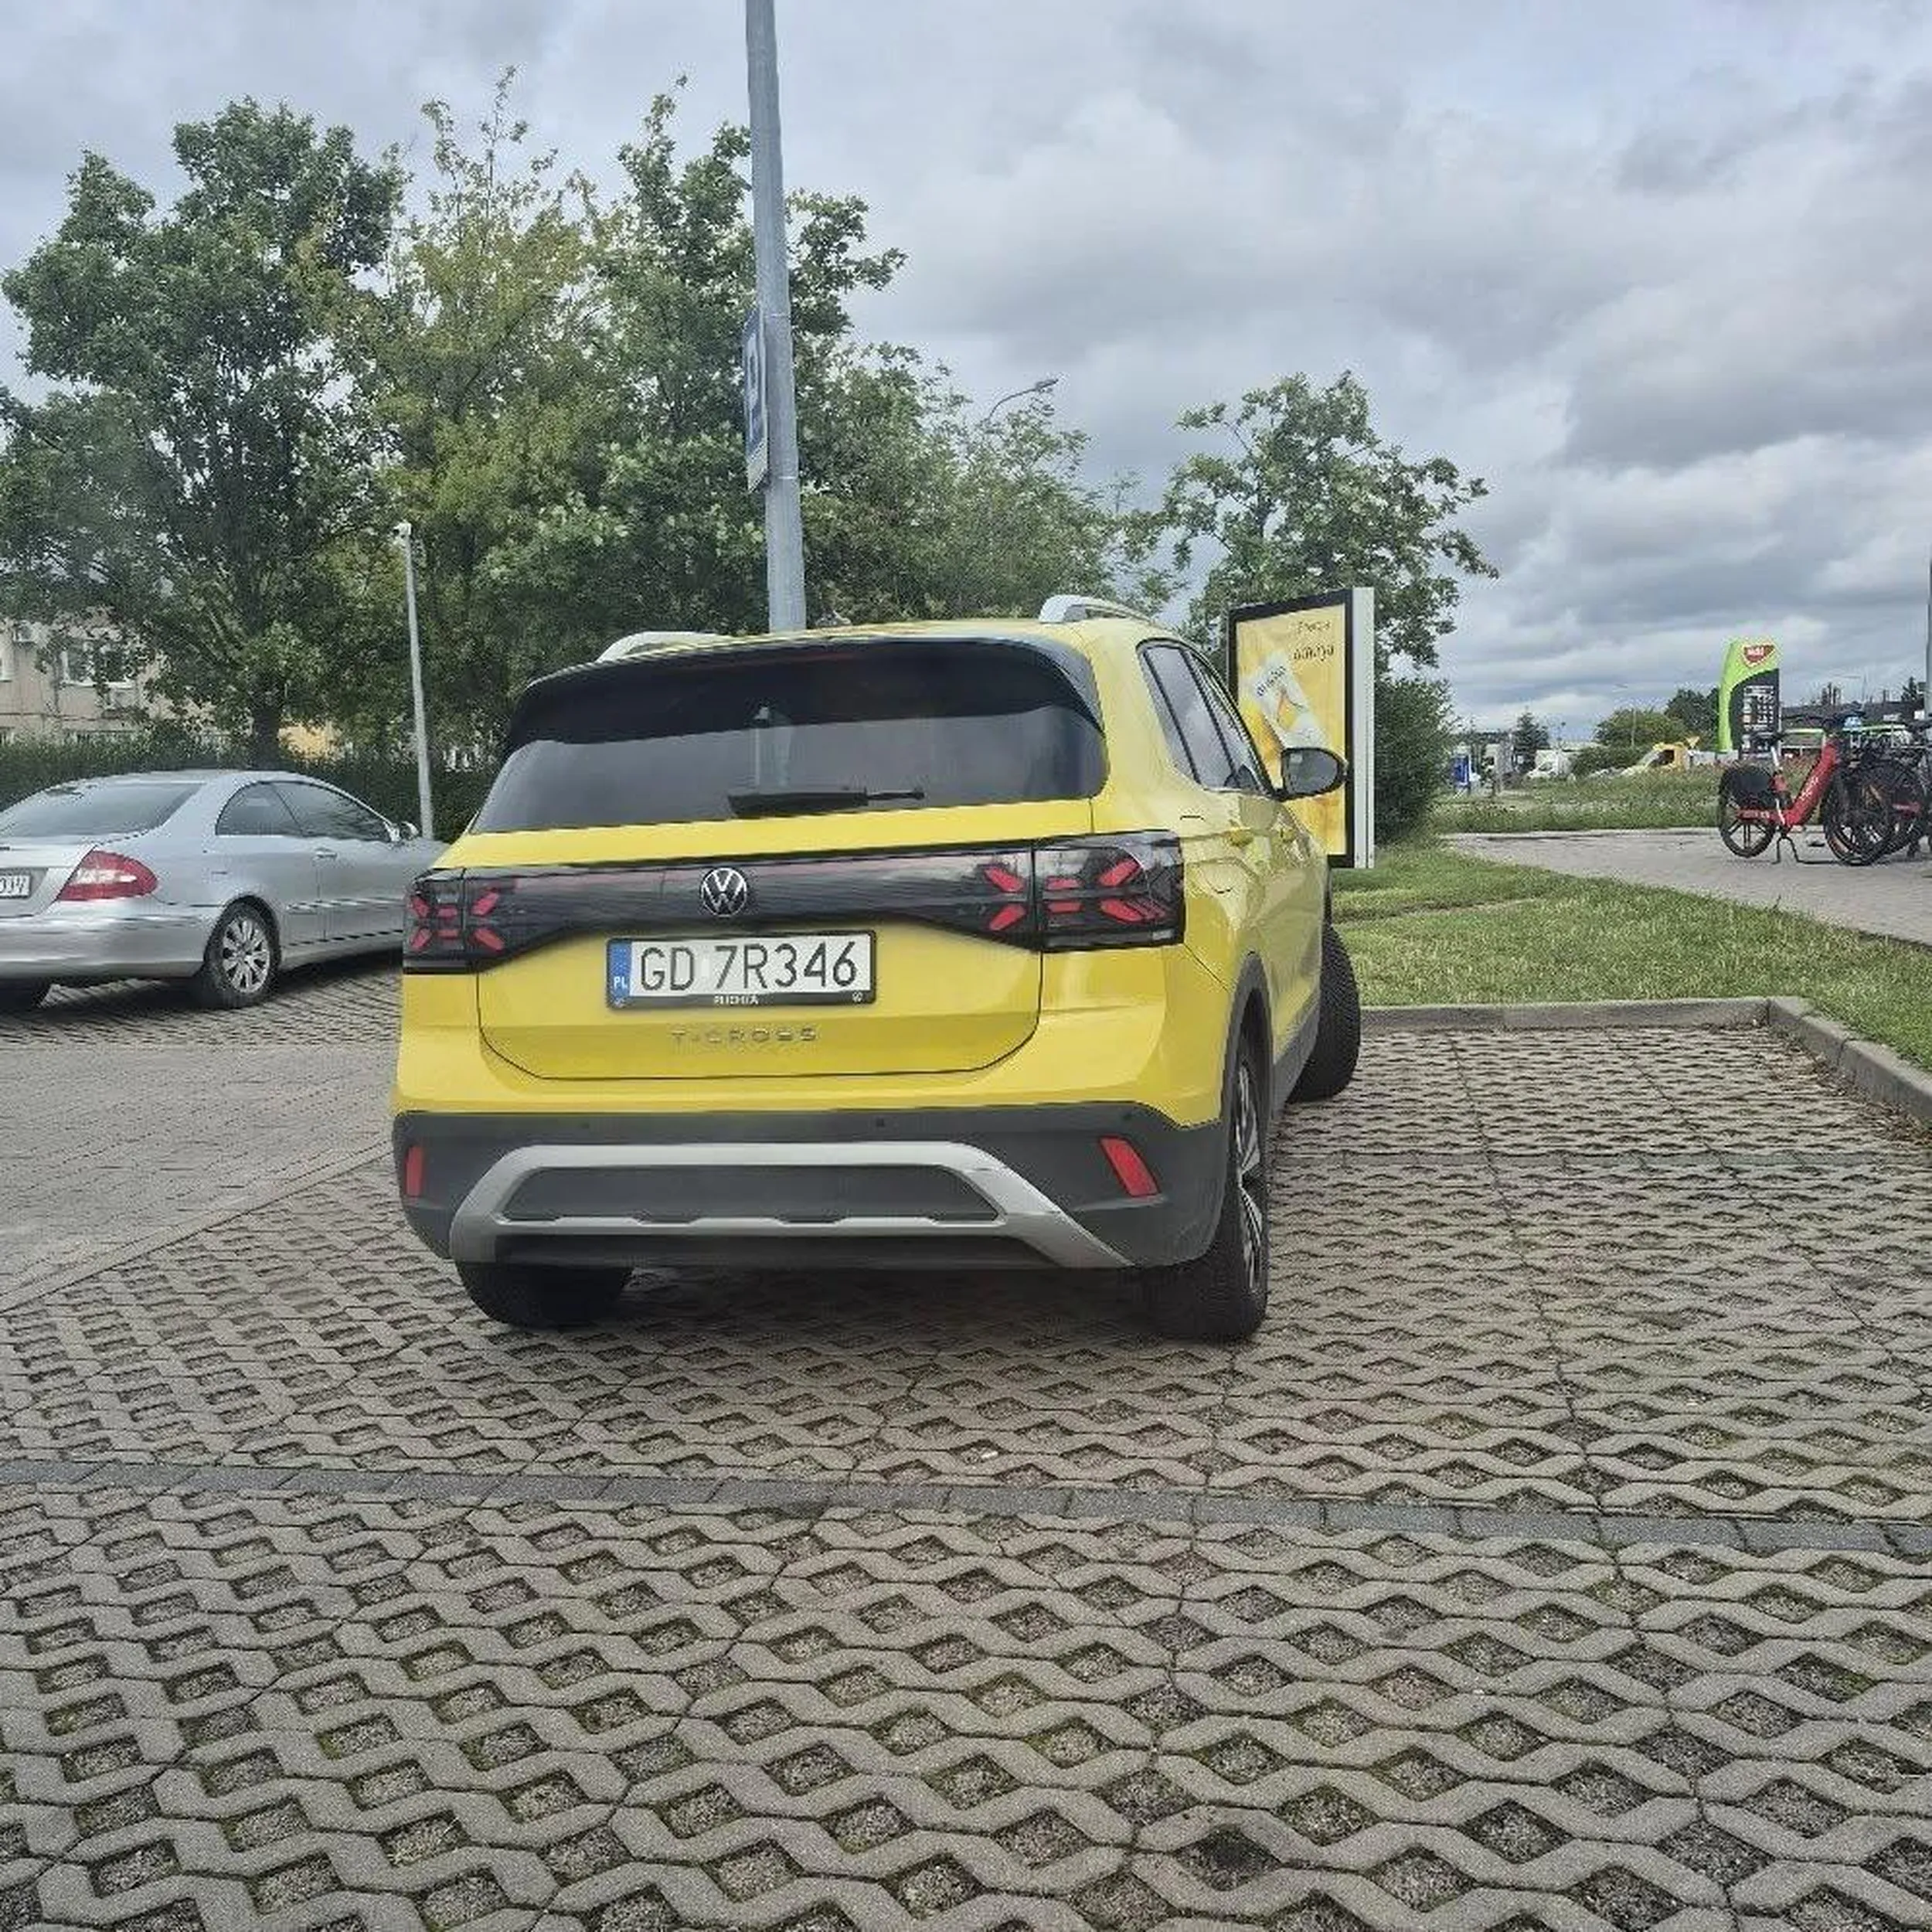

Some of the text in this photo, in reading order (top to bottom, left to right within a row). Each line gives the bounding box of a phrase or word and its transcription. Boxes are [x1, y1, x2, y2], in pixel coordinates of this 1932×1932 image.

[641, 940, 859, 992] GD 7R346
[614, 976, 628, 990] PL
